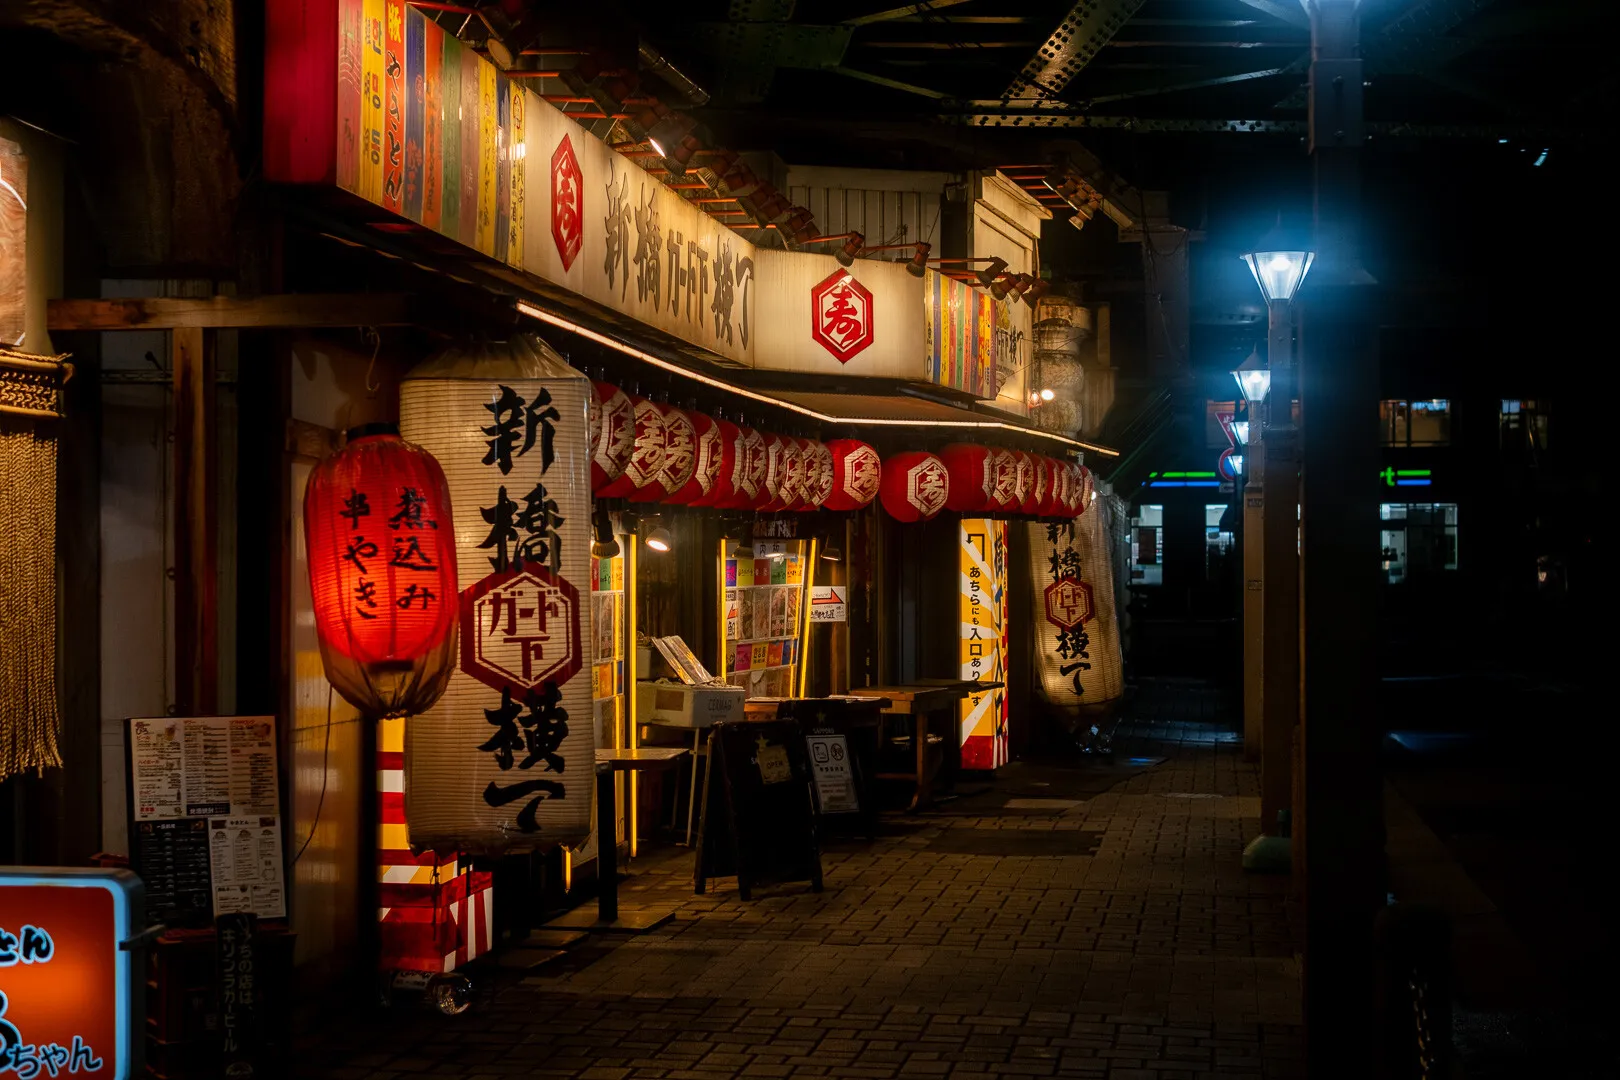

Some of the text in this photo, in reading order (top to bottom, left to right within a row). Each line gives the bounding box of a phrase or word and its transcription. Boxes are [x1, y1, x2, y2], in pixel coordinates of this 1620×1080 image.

[339, 488, 379, 620] 串やき
[388, 487, 438, 611] 煮込み
[969, 566, 983, 708] あちらにも入口ありす
[476, 681, 569, 834] 横丁
[222, 929, 237, 1053] キリンラガービール
